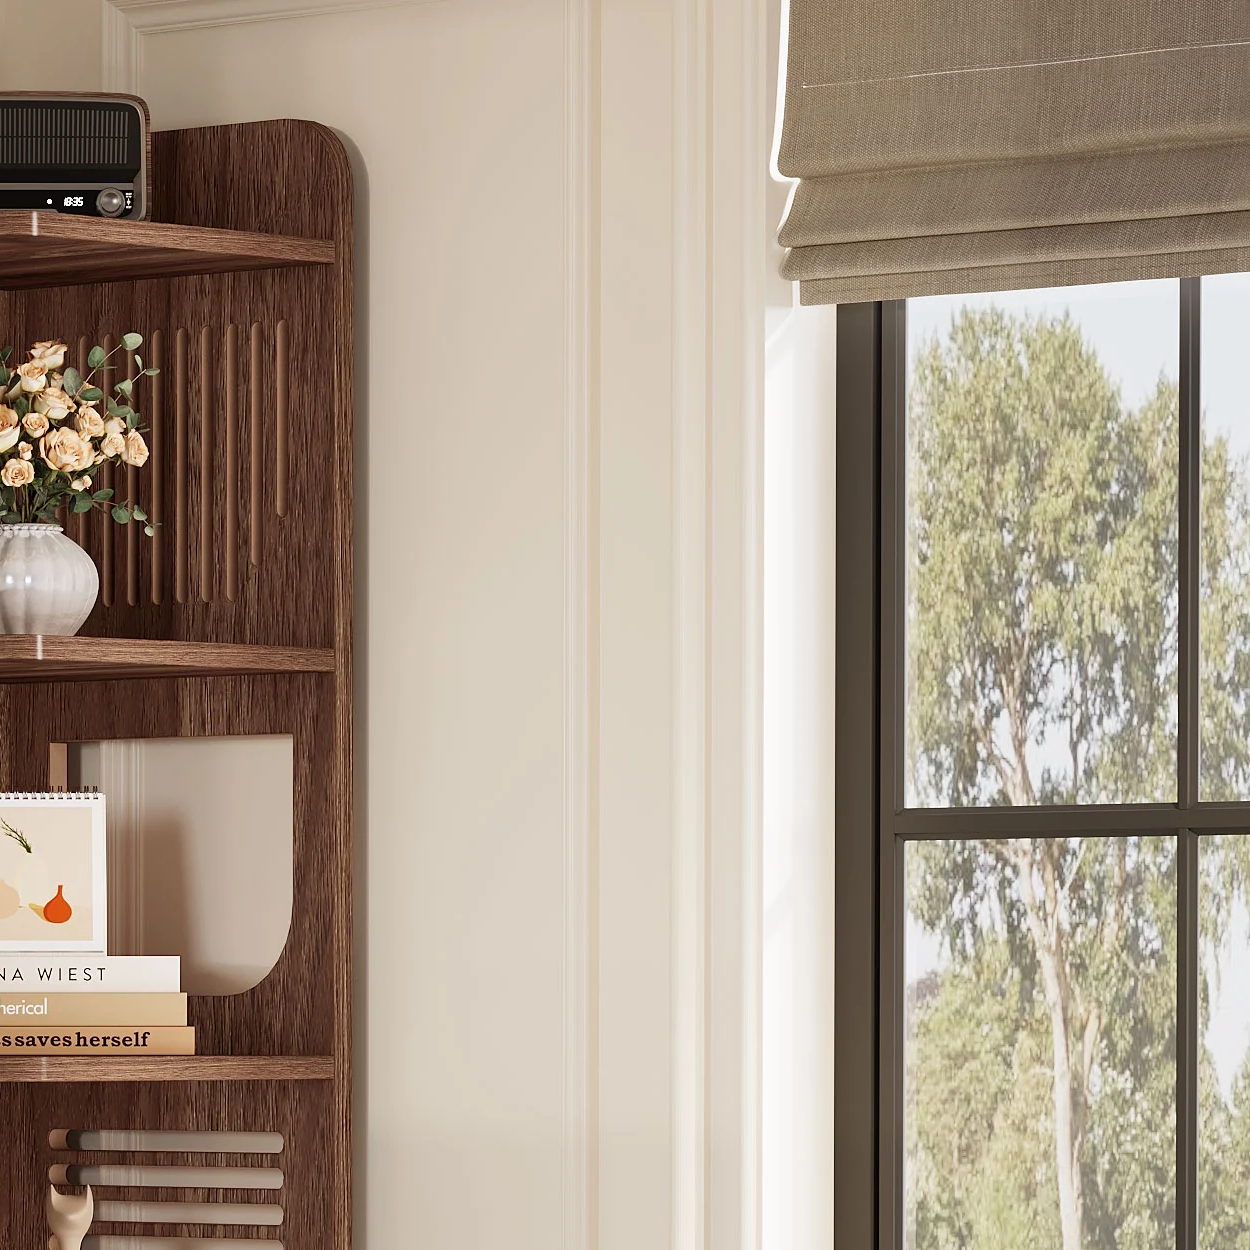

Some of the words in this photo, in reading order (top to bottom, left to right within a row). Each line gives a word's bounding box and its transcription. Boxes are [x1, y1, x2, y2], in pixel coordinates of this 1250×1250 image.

[37, 967, 106, 982] WIEST
[14, 1035, 73, 1048] saves
[75, 1031, 151, 1048] herself
